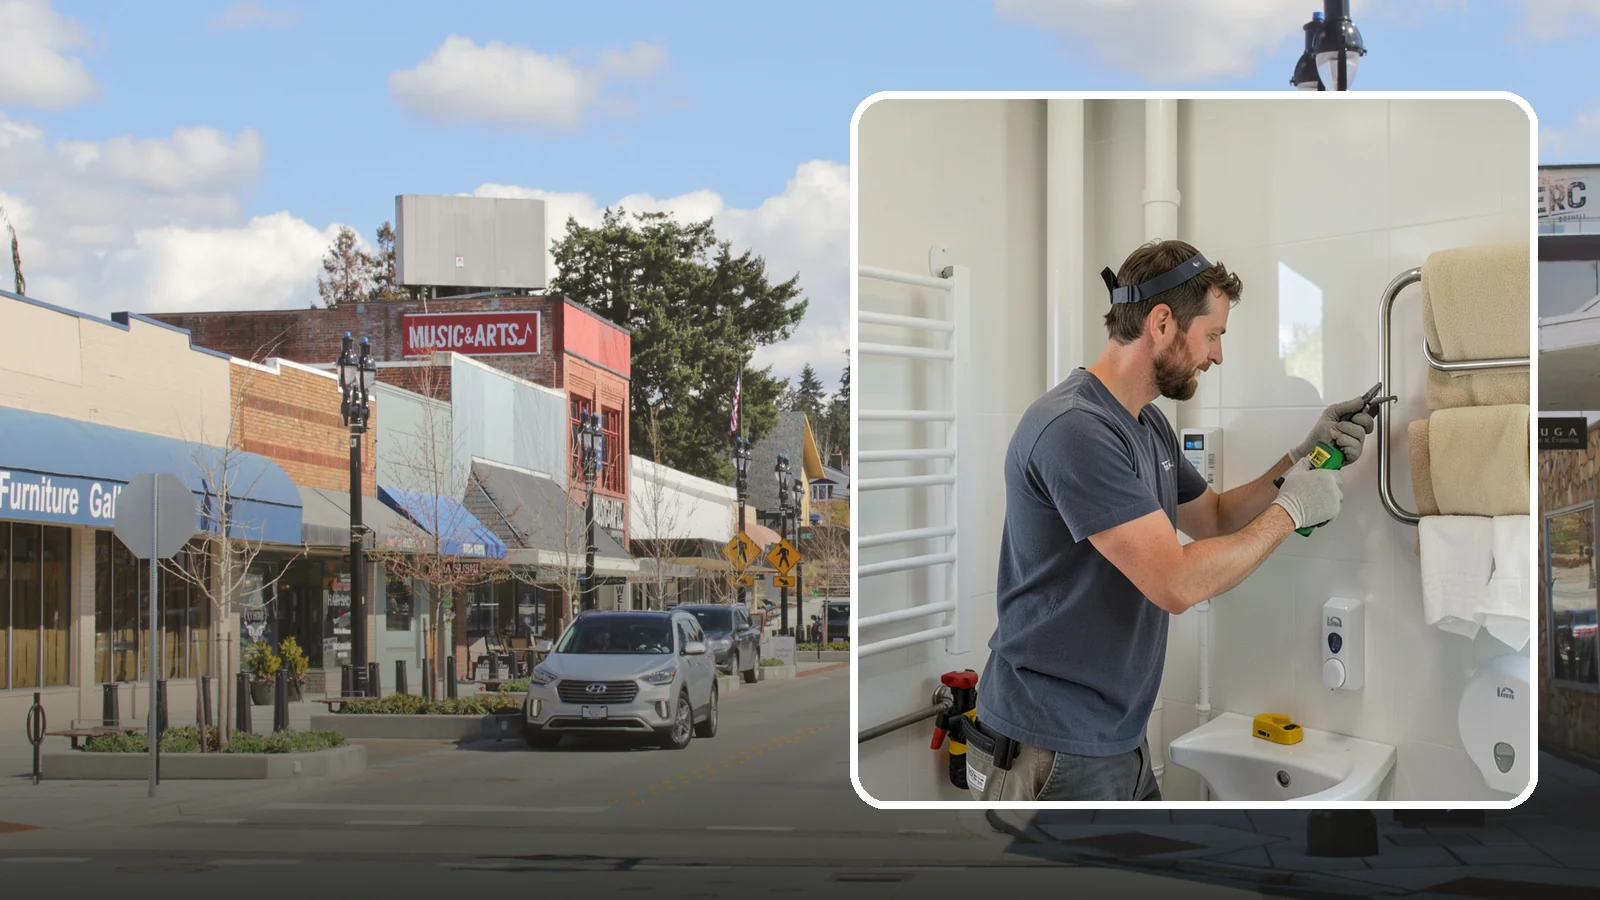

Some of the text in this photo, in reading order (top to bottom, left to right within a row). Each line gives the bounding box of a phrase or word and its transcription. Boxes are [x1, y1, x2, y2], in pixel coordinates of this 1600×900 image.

[0, 471, 121, 519] Furniture Gal
[453, 562, 479, 575] SUSHI
